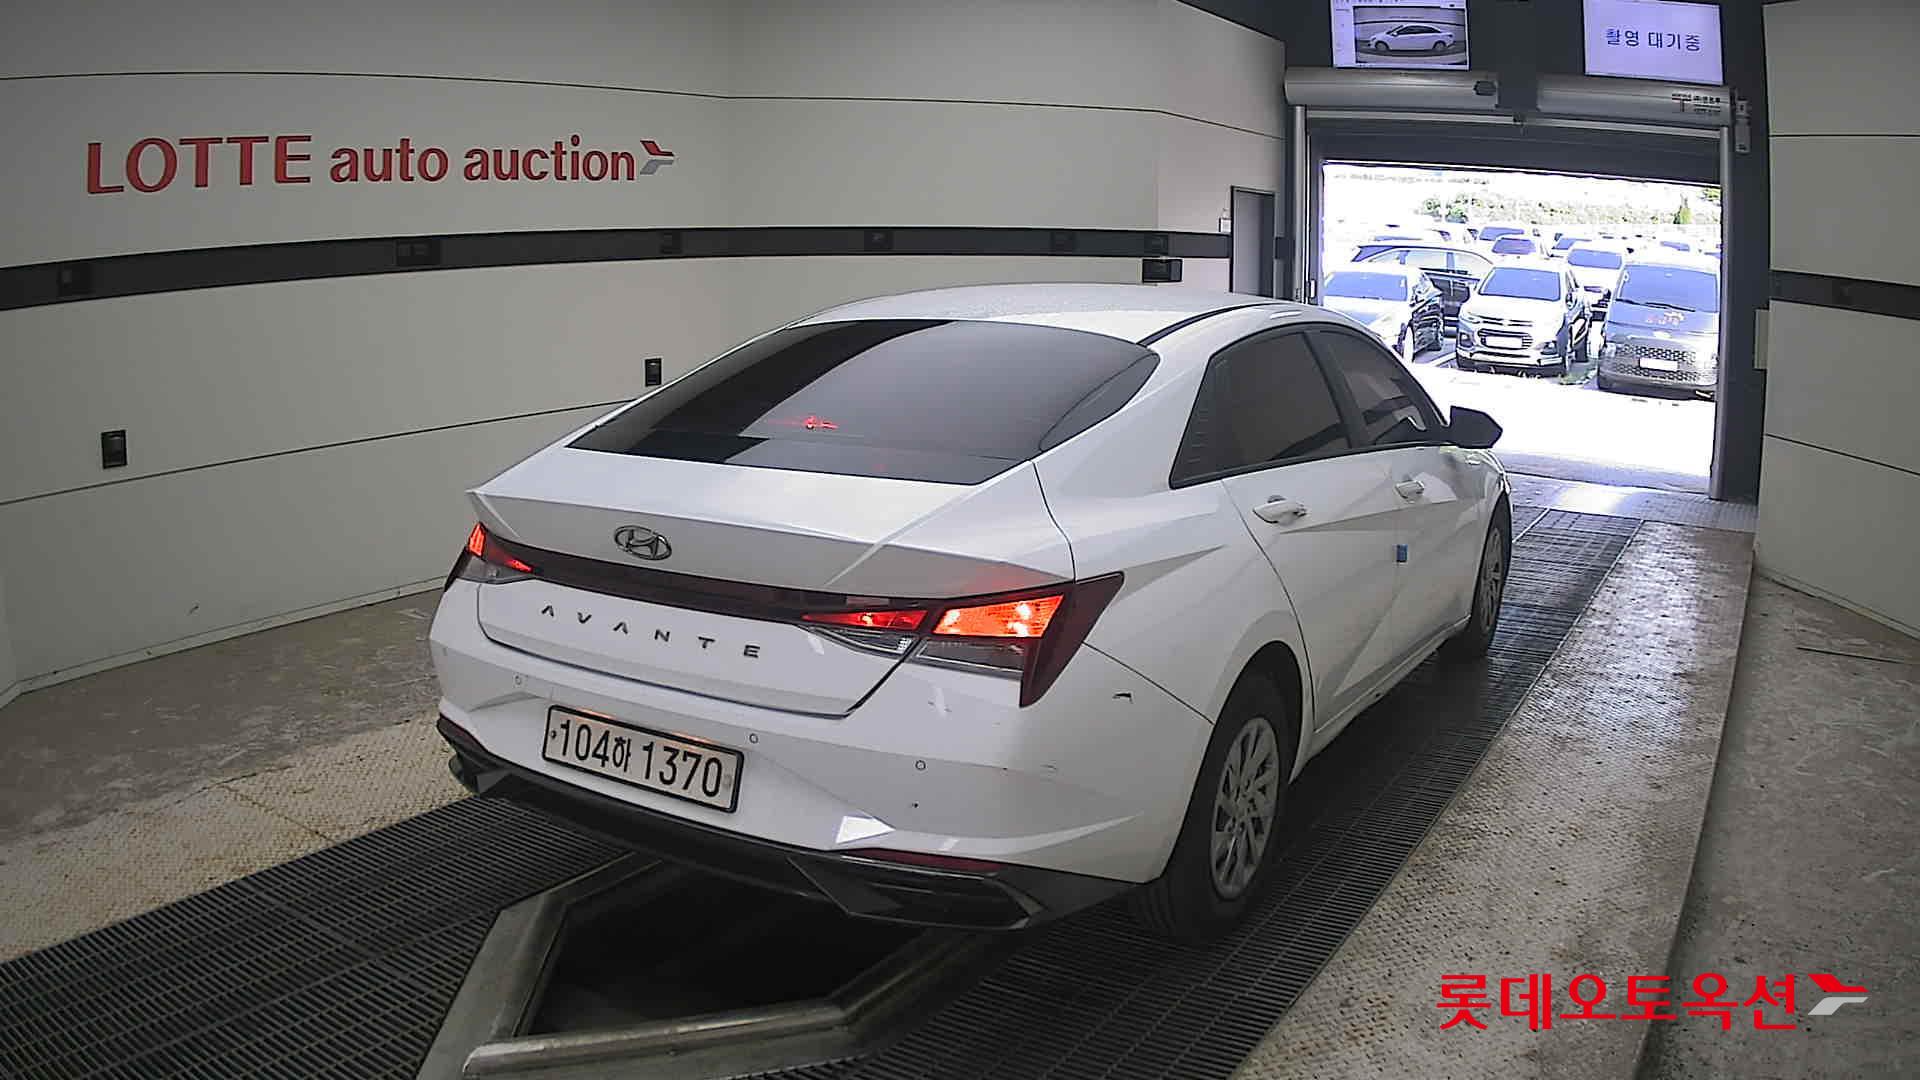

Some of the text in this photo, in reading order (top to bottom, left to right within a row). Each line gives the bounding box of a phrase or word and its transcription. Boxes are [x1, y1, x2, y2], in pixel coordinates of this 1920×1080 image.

[1606, 28, 1701, 52] 촬영 대기중
[86, 134, 635, 195] LOTTE auto auction
[541, 605, 761, 659] AVANTE
[642, 741, 723, 798] 1370
